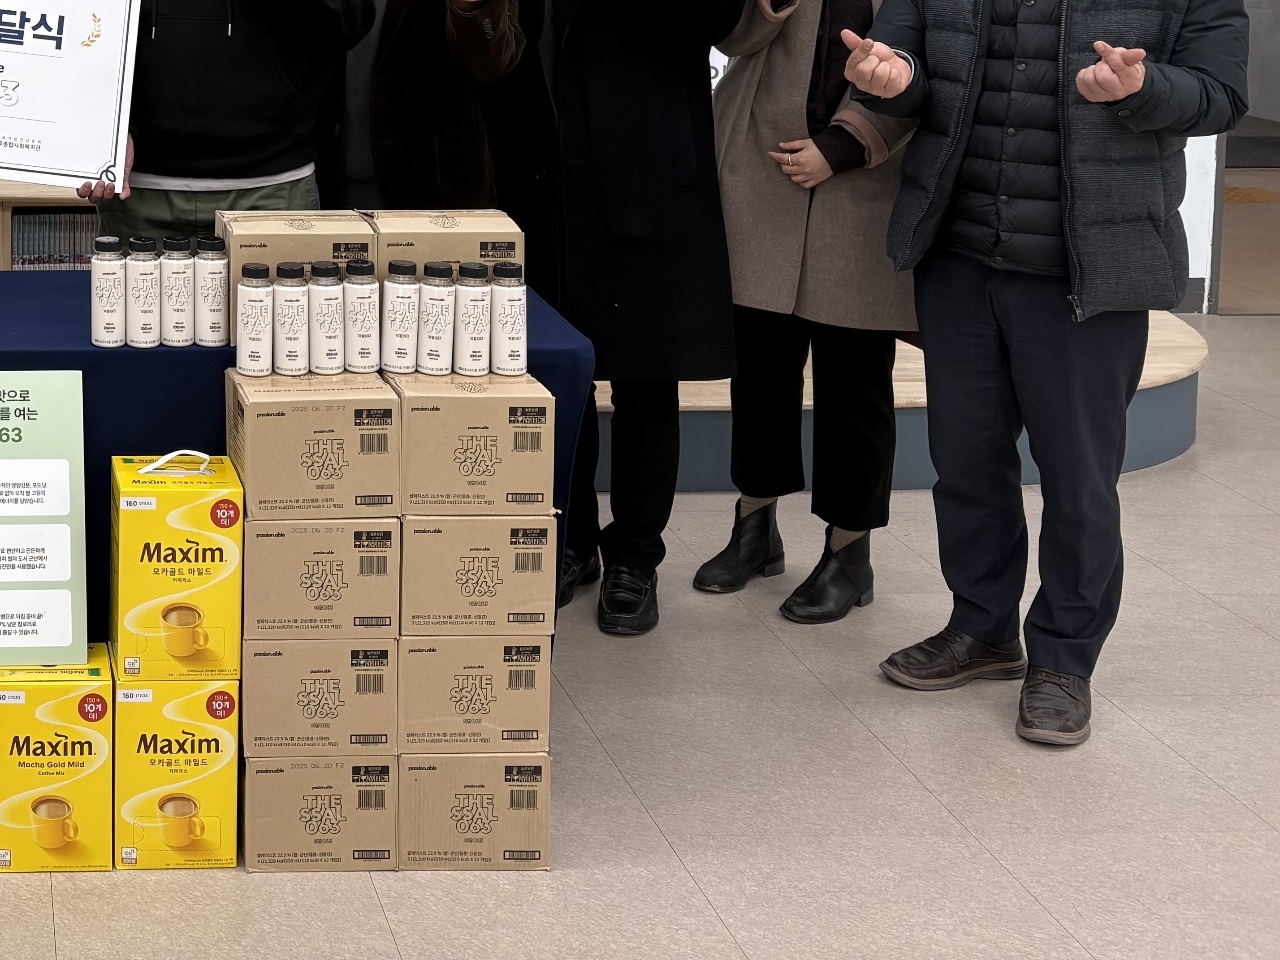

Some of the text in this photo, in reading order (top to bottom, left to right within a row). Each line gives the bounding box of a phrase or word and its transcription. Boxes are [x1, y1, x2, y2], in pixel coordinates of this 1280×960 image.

[14, 407, 38, 420] 여는
[304, 439, 344, 454] THE
[300, 452, 349, 467] SSAL
[307, 465, 344, 480] 063
[216, 509, 235, 518] 10개
[152, 567, 212, 576] 모카골드 마일드
[18, 760, 85, 769] Mocha Gold Mild
[149, 758, 209, 767] 모카골드 마일드
[454, 793, 495, 808] THE
[450, 806, 499, 821] SSAL
[455, 820, 492, 835] 063
